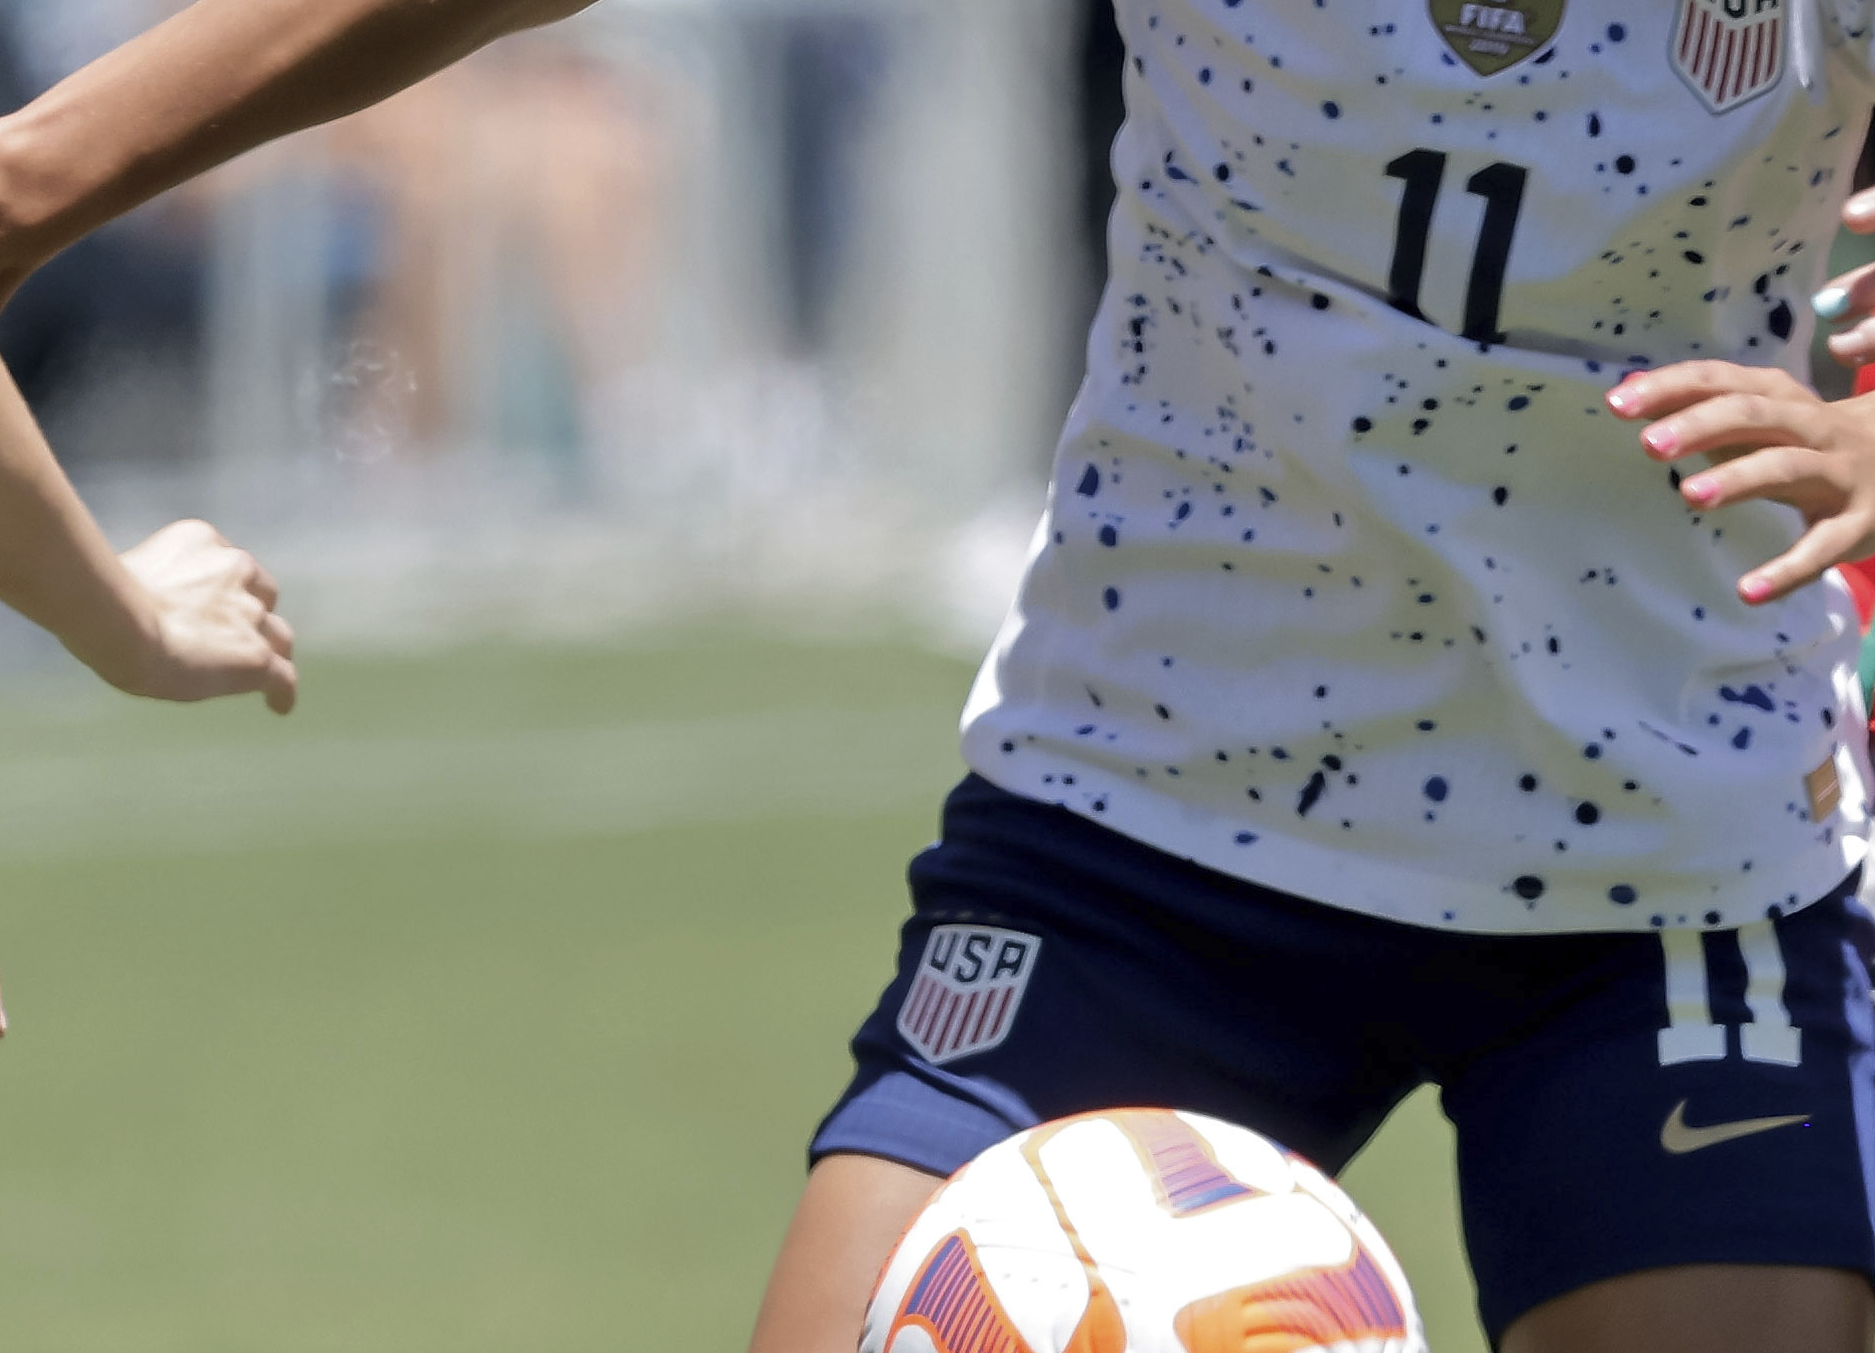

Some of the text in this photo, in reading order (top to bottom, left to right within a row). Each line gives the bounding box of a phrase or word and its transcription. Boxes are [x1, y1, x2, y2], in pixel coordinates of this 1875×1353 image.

[1459, 2, 1526, 35] FIFA
[1385, 147, 1528, 345] 11
[930, 932, 1027, 983] USA
[1657, 920, 1802, 1068] 11
